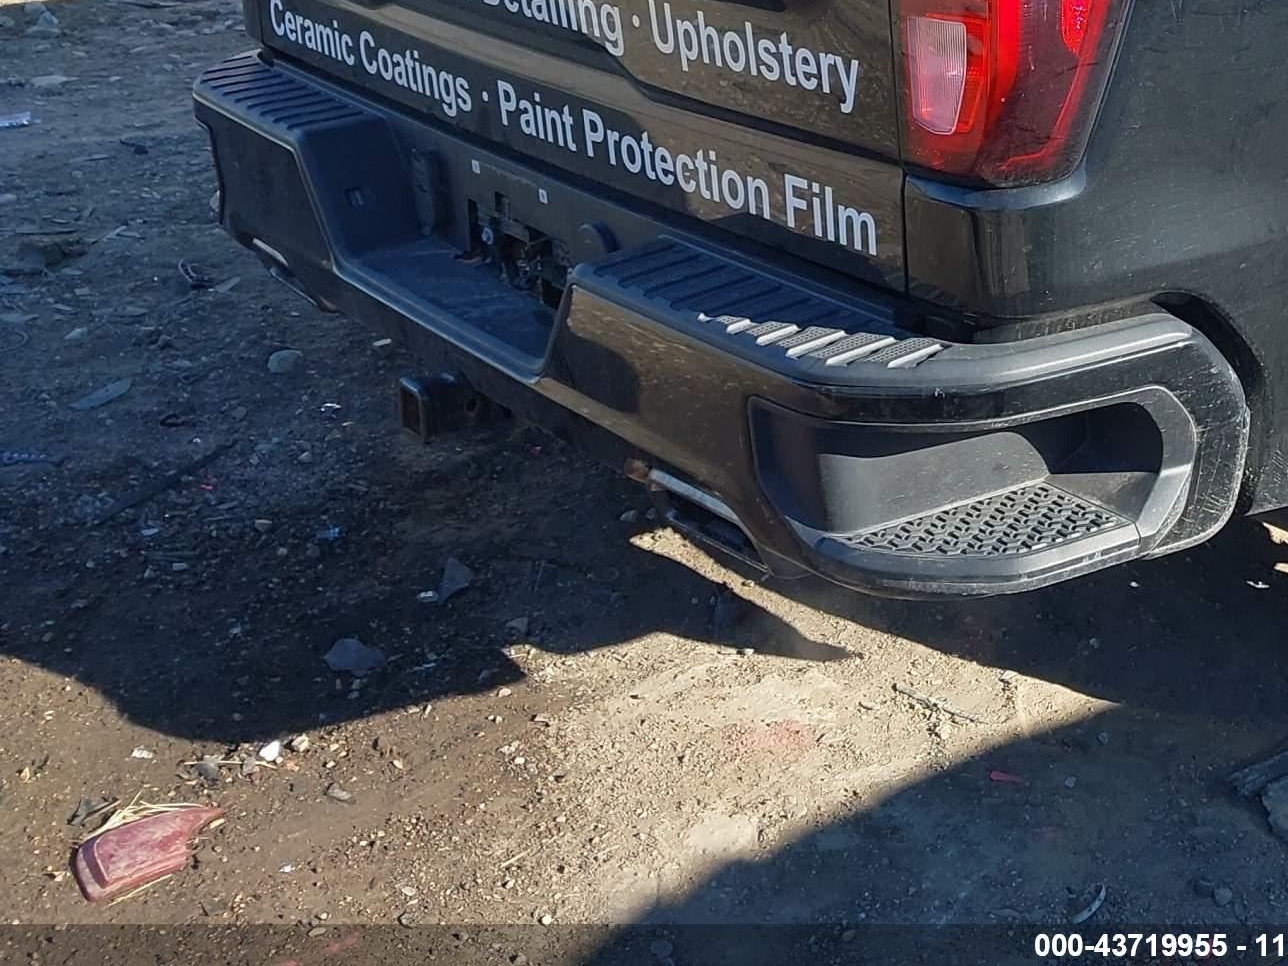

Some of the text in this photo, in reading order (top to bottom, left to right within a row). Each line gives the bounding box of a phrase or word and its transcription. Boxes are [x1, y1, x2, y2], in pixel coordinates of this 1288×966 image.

[359, 30, 472, 115] Coatings
[497, 80, 577, 152] Paint
[585, 114, 771, 222] Protection
[783, 174, 879, 256] Film
